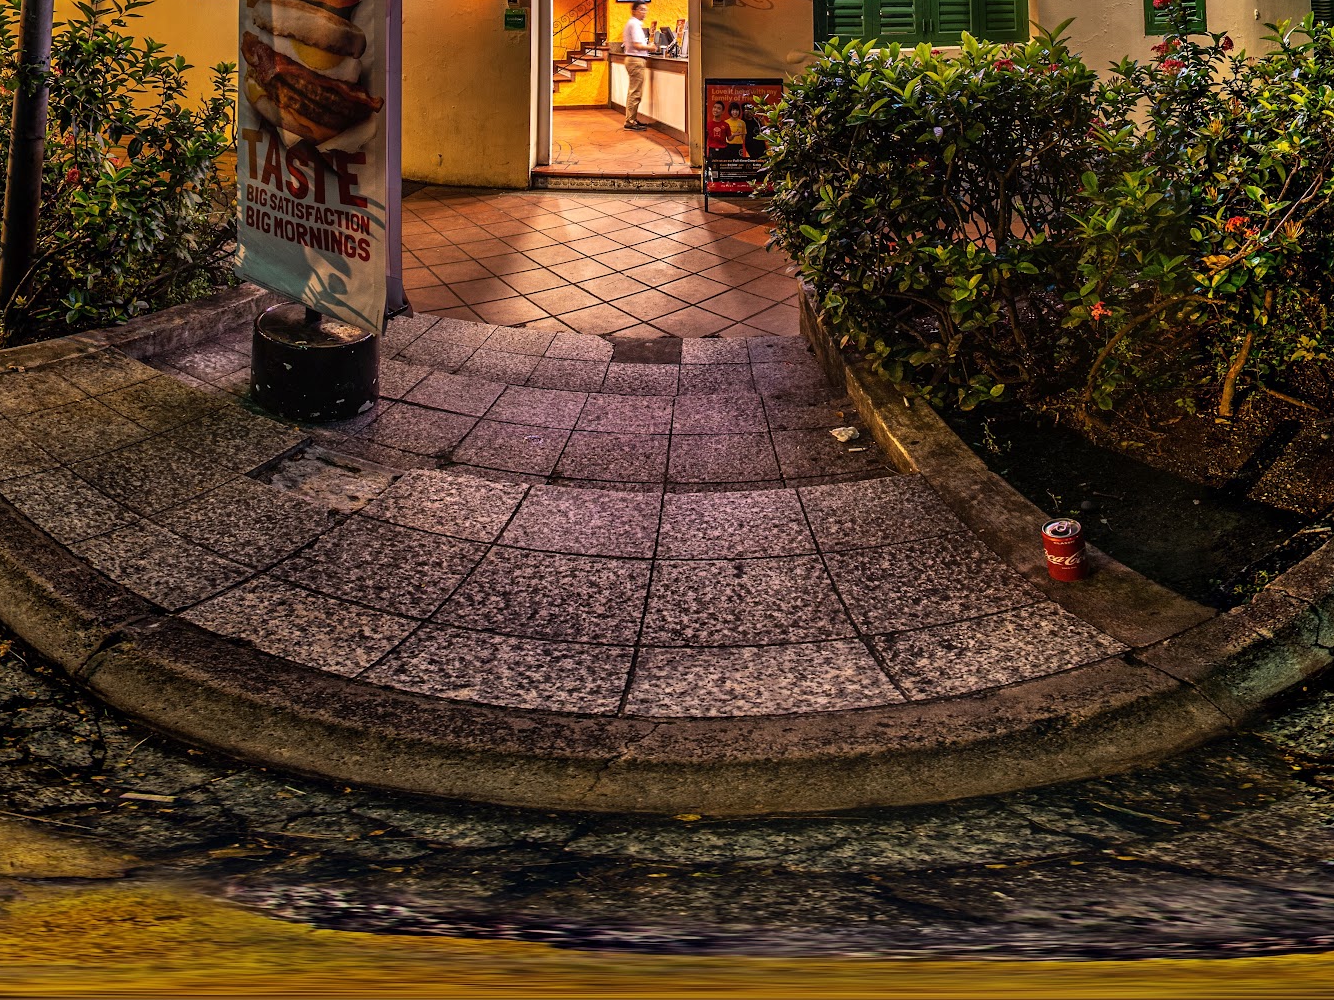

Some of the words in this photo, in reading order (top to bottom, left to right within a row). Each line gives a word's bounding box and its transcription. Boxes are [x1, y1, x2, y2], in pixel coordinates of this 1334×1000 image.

[766, 89, 778, 97] my
[242, 128, 369, 209] TASTE
[246, 183, 267, 207] BIG
[269, 193, 370, 236] SATISFACTION
[246, 205, 271, 234] BIG
[274, 215, 371, 262] MORNINGS
